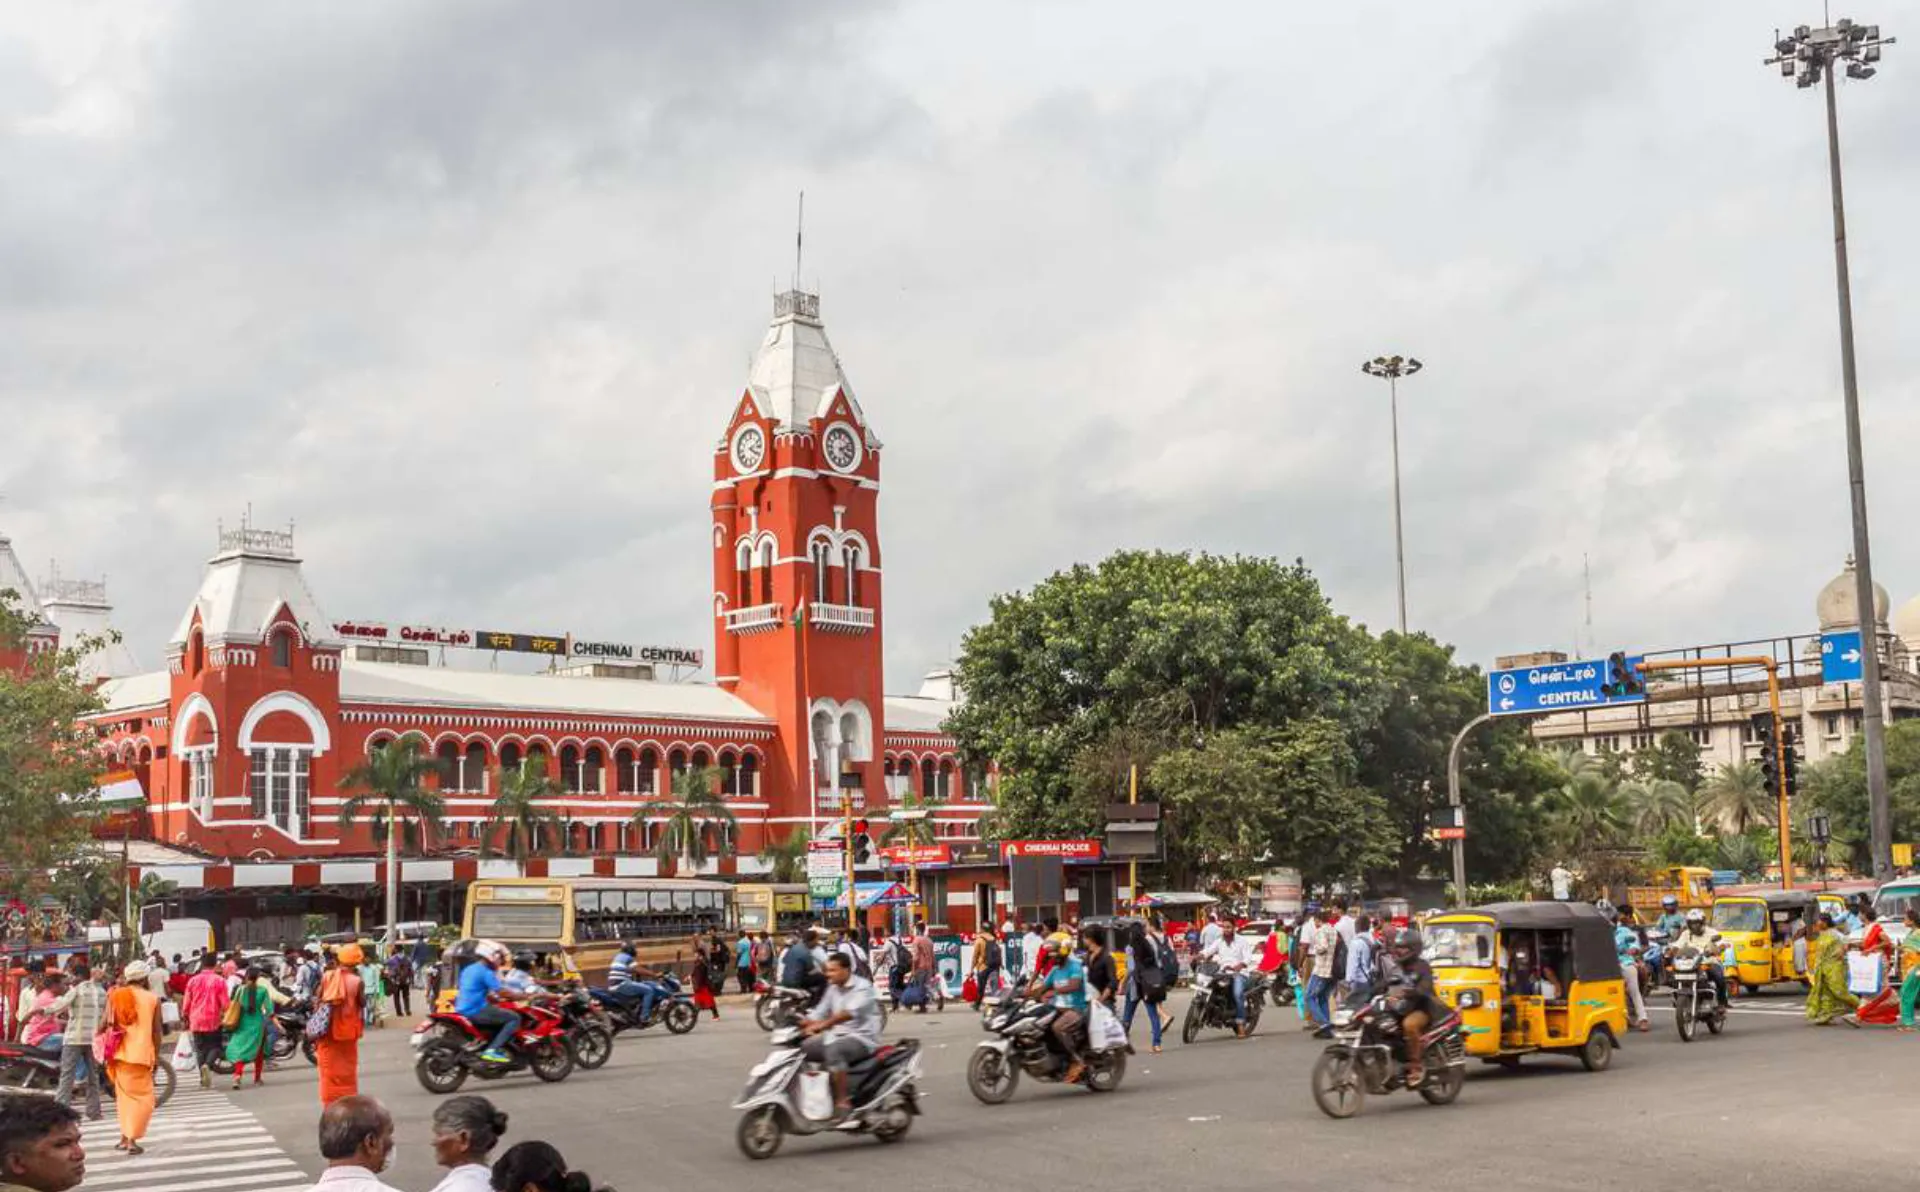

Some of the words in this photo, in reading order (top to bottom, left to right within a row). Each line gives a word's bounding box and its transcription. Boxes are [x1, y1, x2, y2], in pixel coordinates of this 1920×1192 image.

[573, 642, 632, 657] CHENNAI
[641, 648, 700, 663] CENTRAL
[1539, 690, 1597, 705] CENTRAL
[1024, 843, 1060, 852] CHENNAI
[1061, 843, 1090, 852] POLICE
